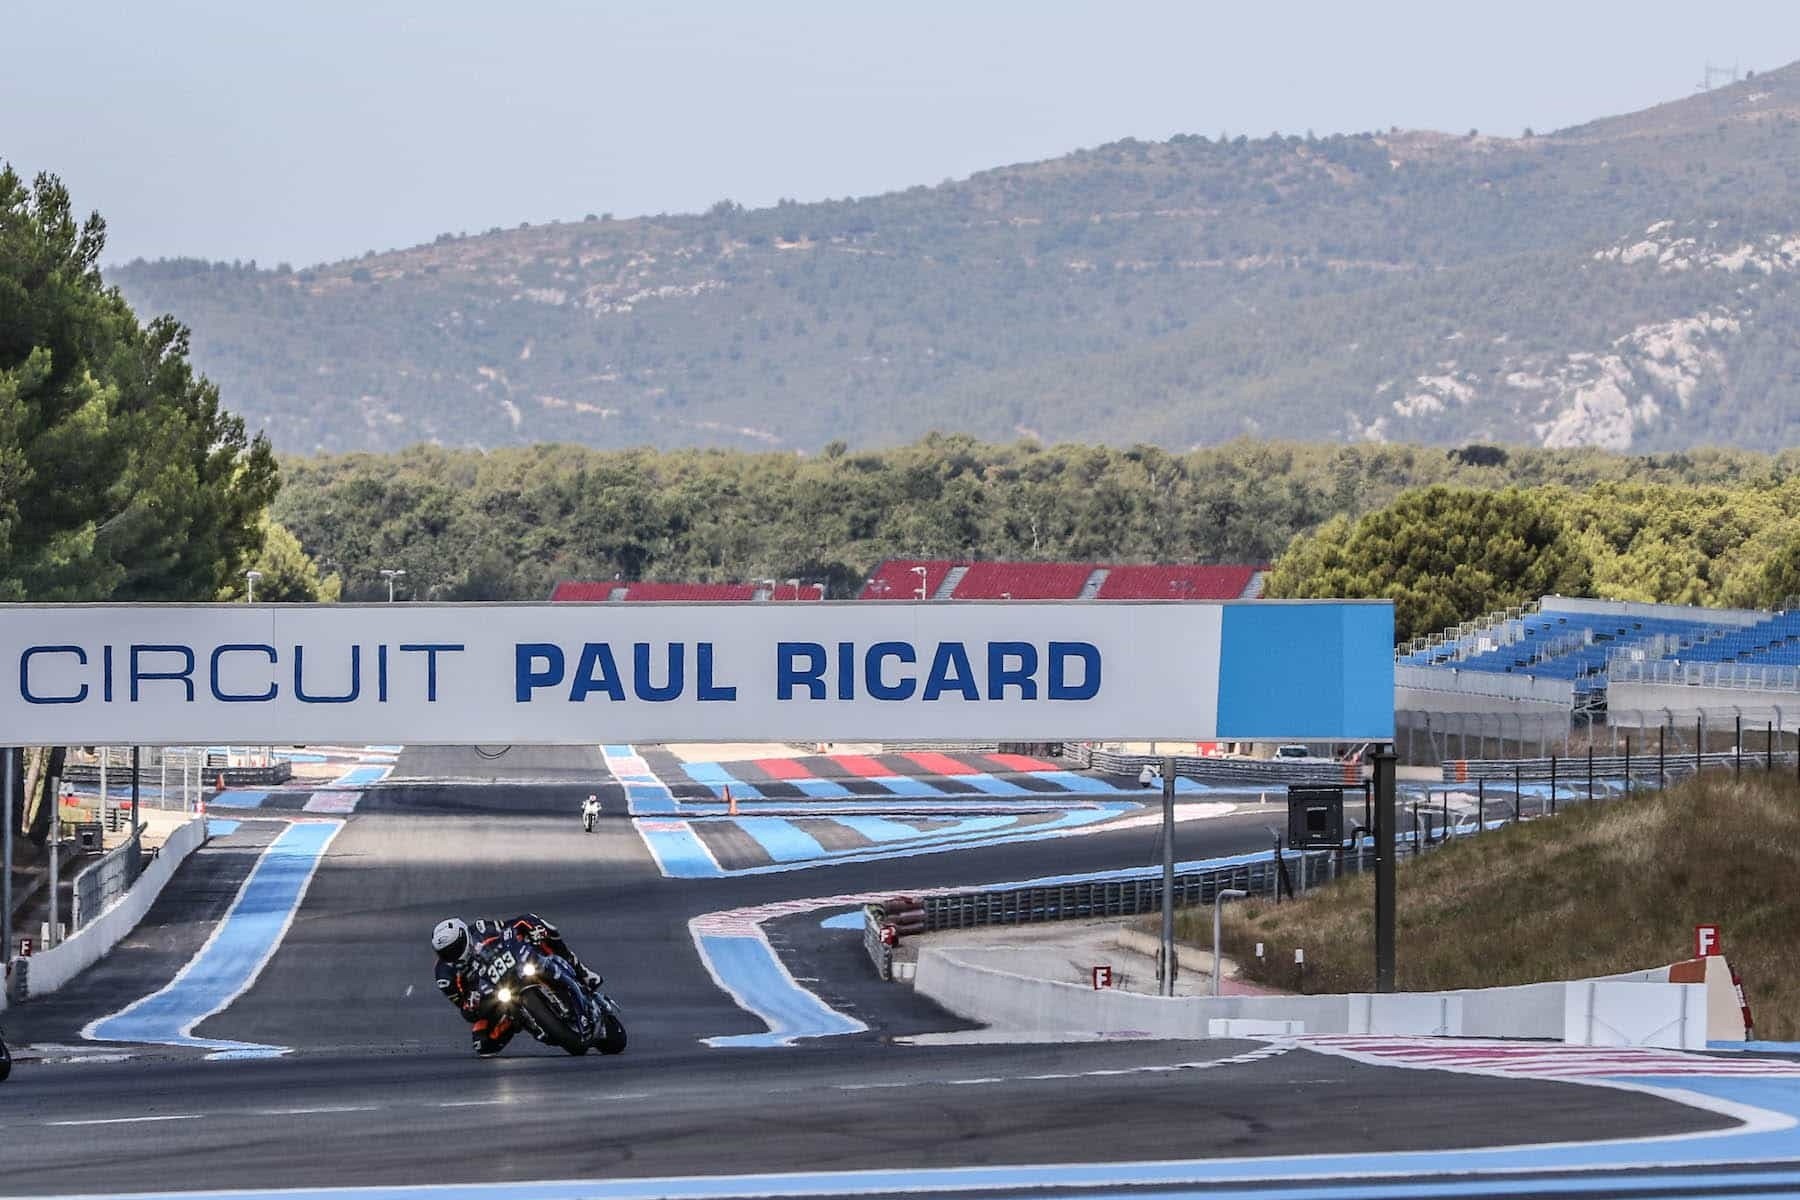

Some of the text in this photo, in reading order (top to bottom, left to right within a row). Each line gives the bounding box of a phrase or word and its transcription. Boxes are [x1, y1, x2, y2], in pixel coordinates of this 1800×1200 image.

[19, 641, 1103, 705] CIRCUIT PAUL RICARD
[1699, 928, 1715, 955] F
[487, 950, 516, 984] 333
[1096, 969, 1108, 989] F
